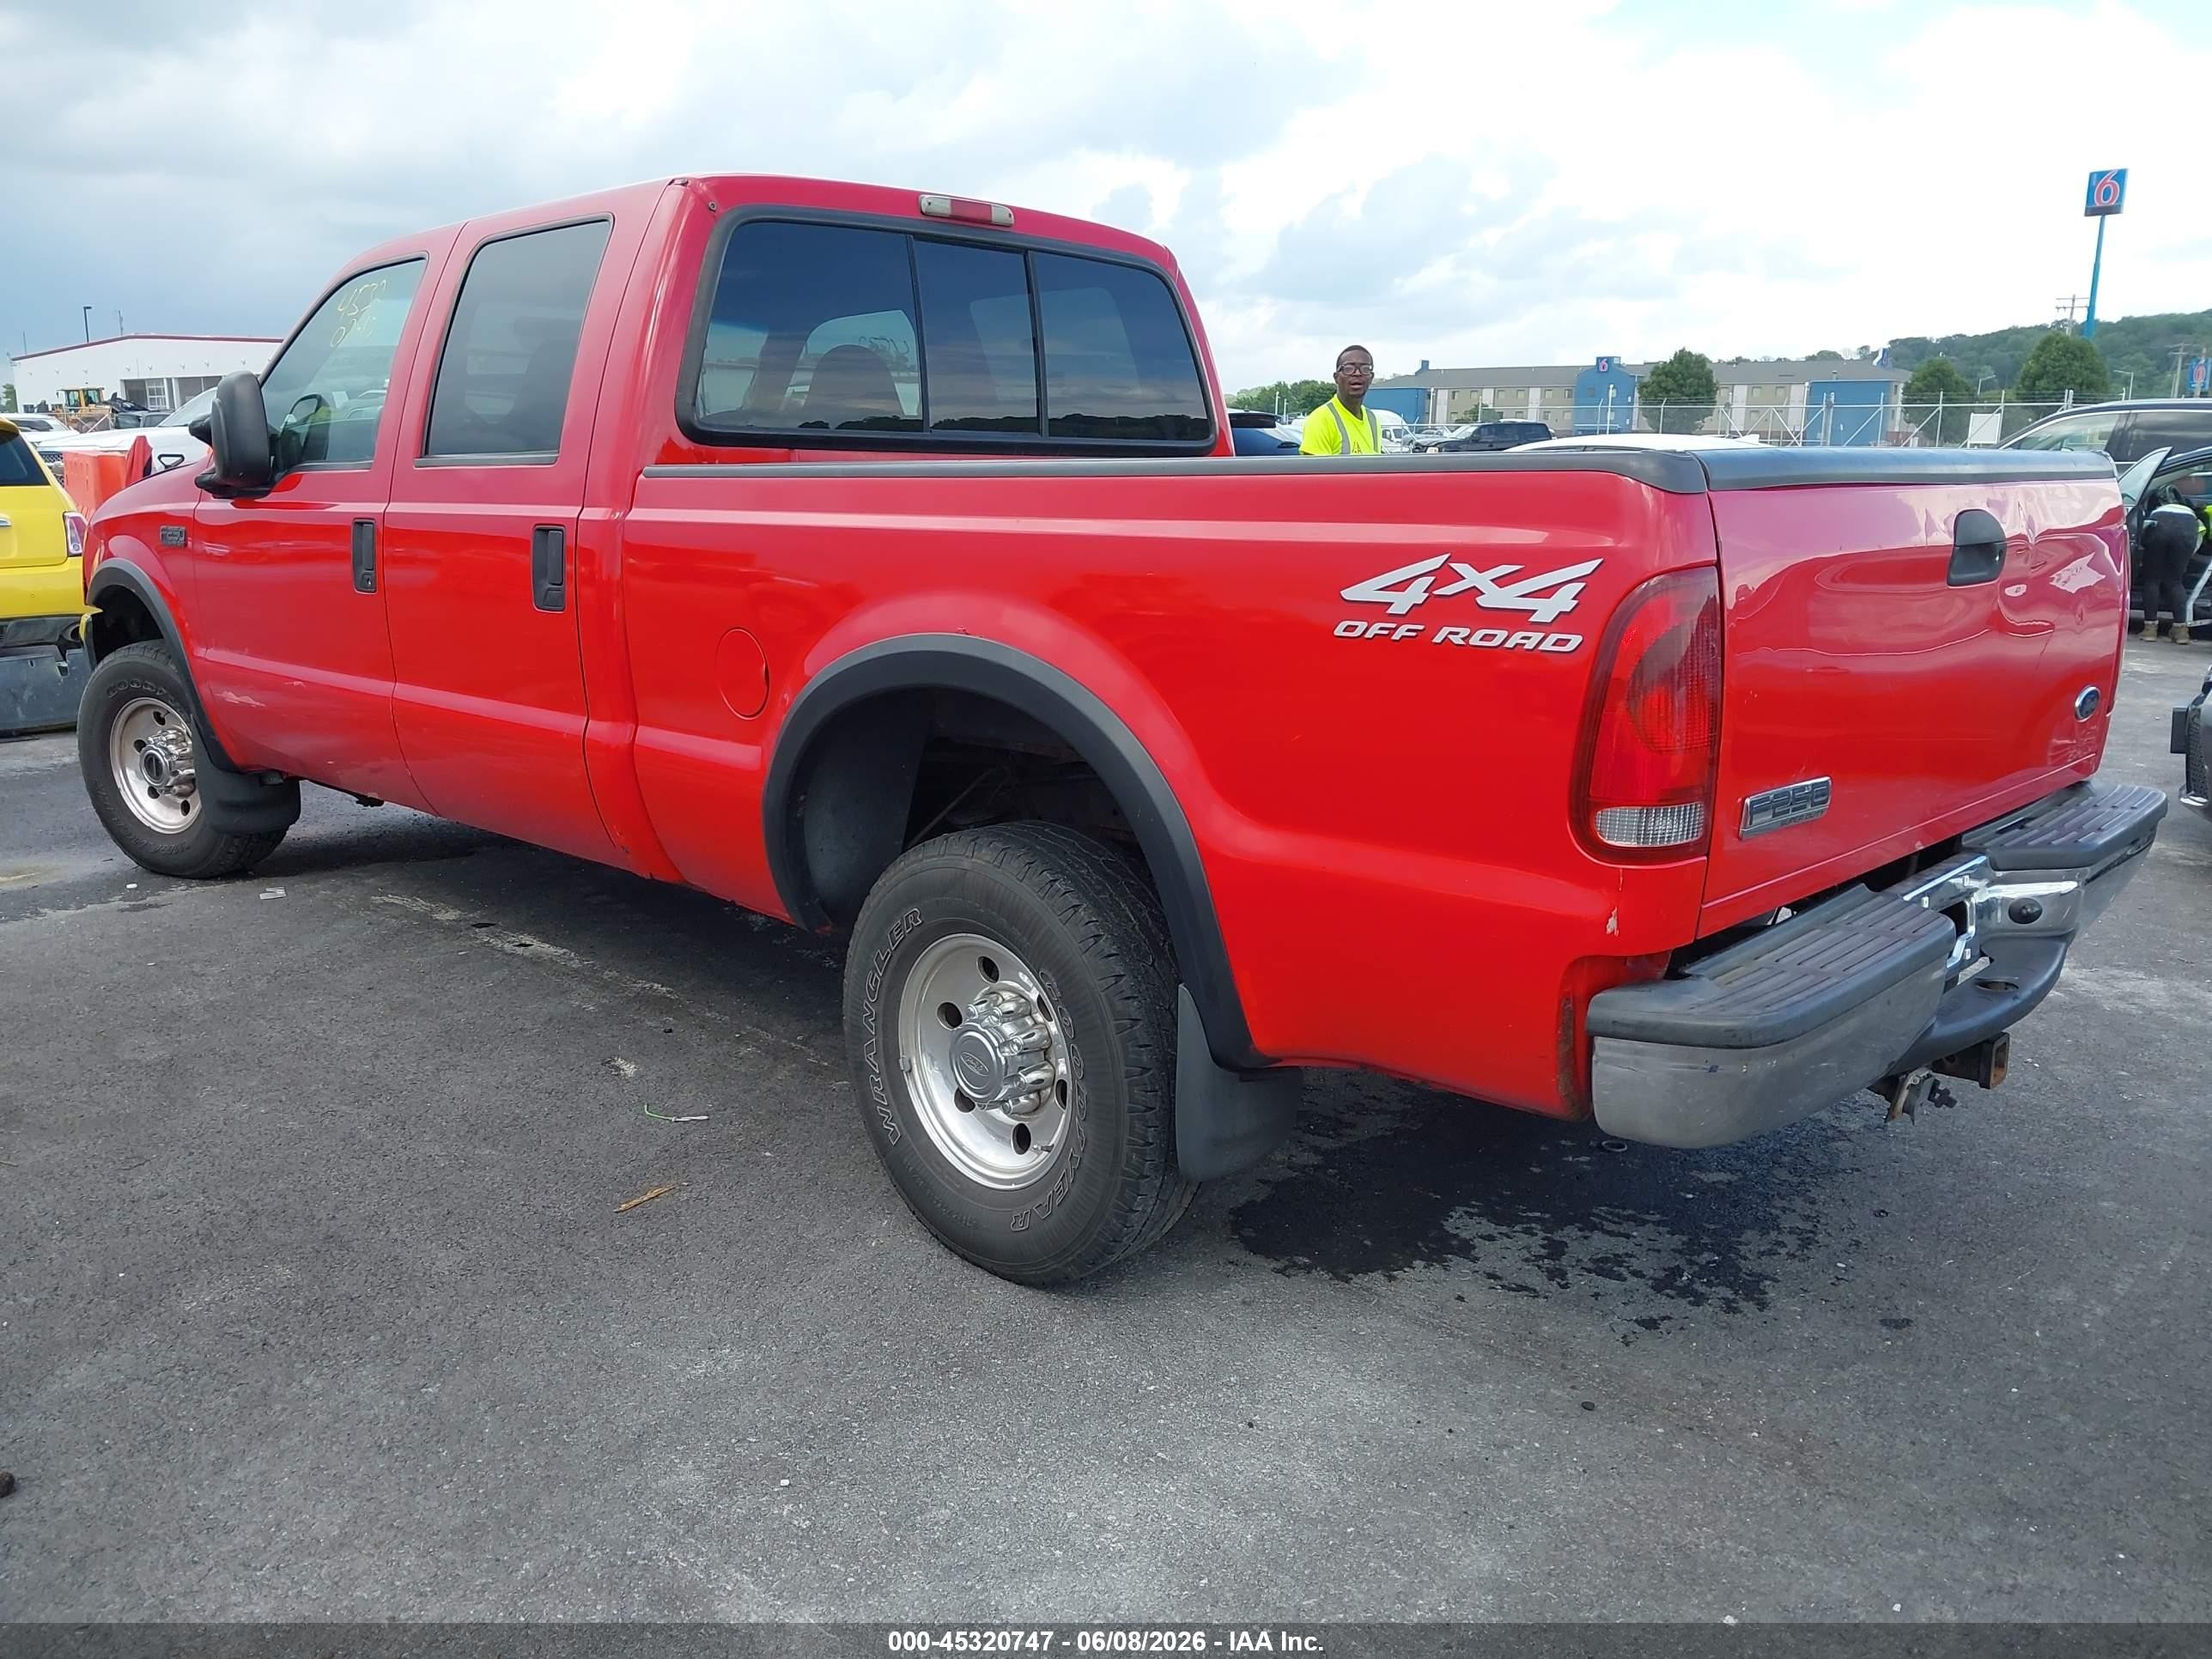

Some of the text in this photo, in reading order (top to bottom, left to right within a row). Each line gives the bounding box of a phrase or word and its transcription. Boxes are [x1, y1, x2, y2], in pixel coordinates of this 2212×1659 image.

[2094, 170, 2119, 206] 6
[1334, 620, 1584, 653] OFF ROAD
[862, 907, 924, 1146] WRANGLER
[1010, 969, 1087, 1233] GOODYEAR
